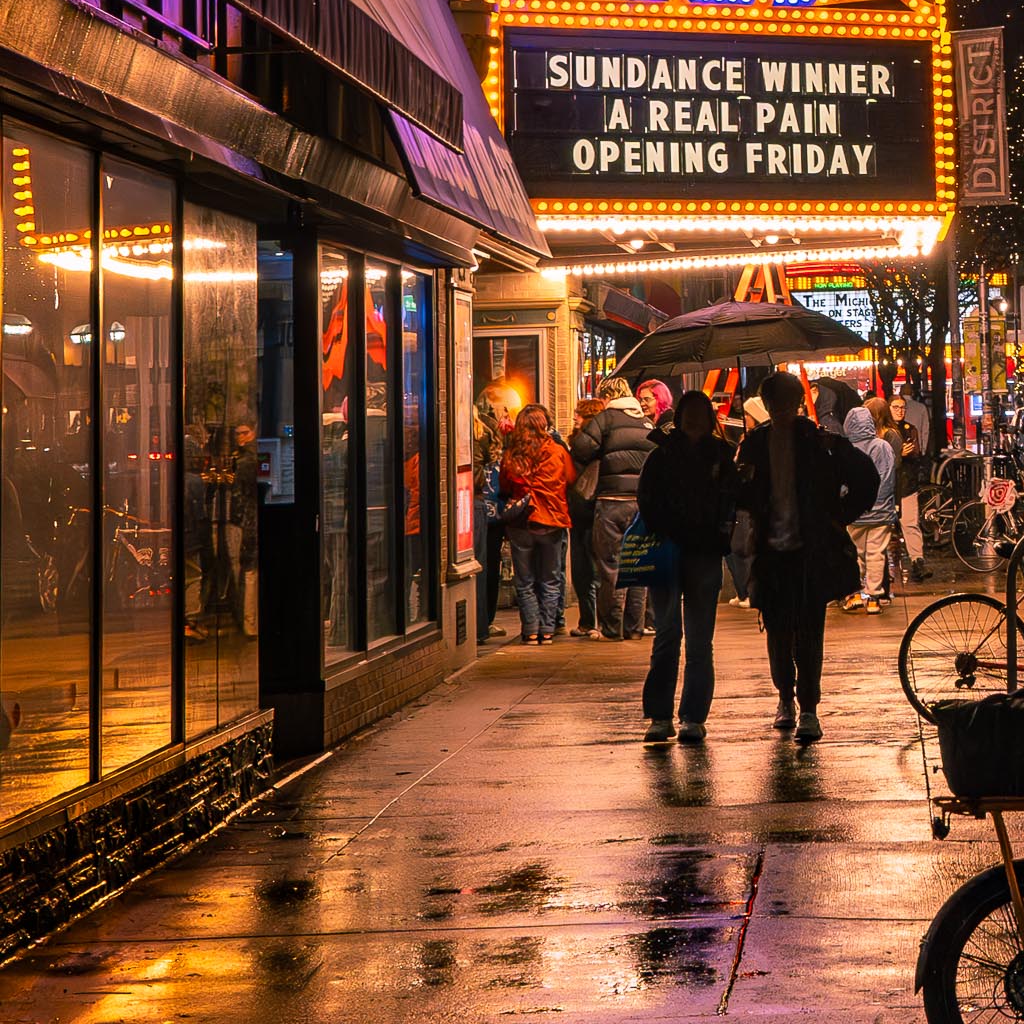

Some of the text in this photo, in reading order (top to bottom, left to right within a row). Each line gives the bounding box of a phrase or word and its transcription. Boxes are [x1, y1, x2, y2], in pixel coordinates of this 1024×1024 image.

[549, 55, 891, 95] SUNDANCE WINNER
[608, 98, 837, 134] A REAL PAIN
[967, 46, 997, 188] DISTRICT
[572, 138, 874, 175] OPENING FRIDAY
[828, 309, 842, 317] ON
